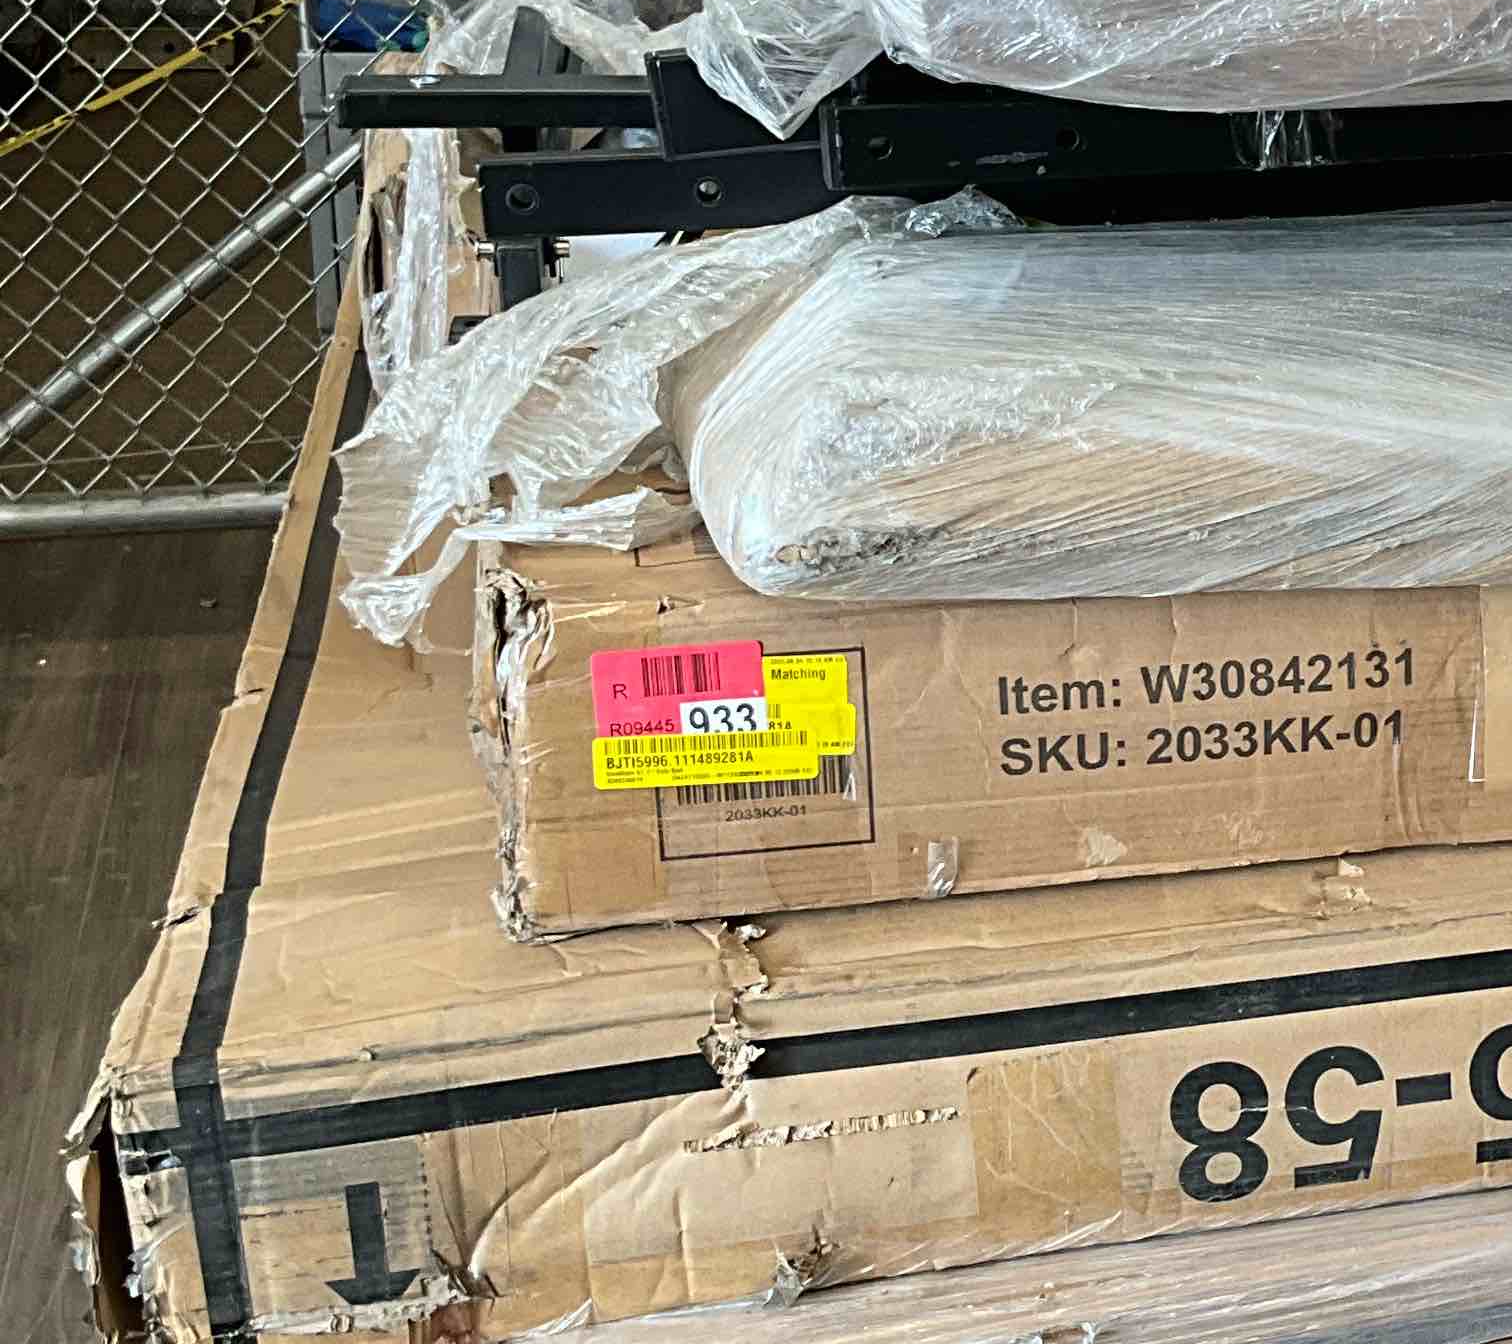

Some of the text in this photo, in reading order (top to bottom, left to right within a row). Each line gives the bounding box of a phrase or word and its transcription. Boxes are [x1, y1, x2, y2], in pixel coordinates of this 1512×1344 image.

[770, 667, 827, 681] Matching
[998, 647, 1416, 716] Item: W30842131
[612, 683, 628, 700] R
[609, 718, 675, 738] R09445
[688, 702, 757, 735] 933
[1000, 708, 1405, 776] SKU: 2033KK-01
[725, 804, 807, 823] 2033KK-01
